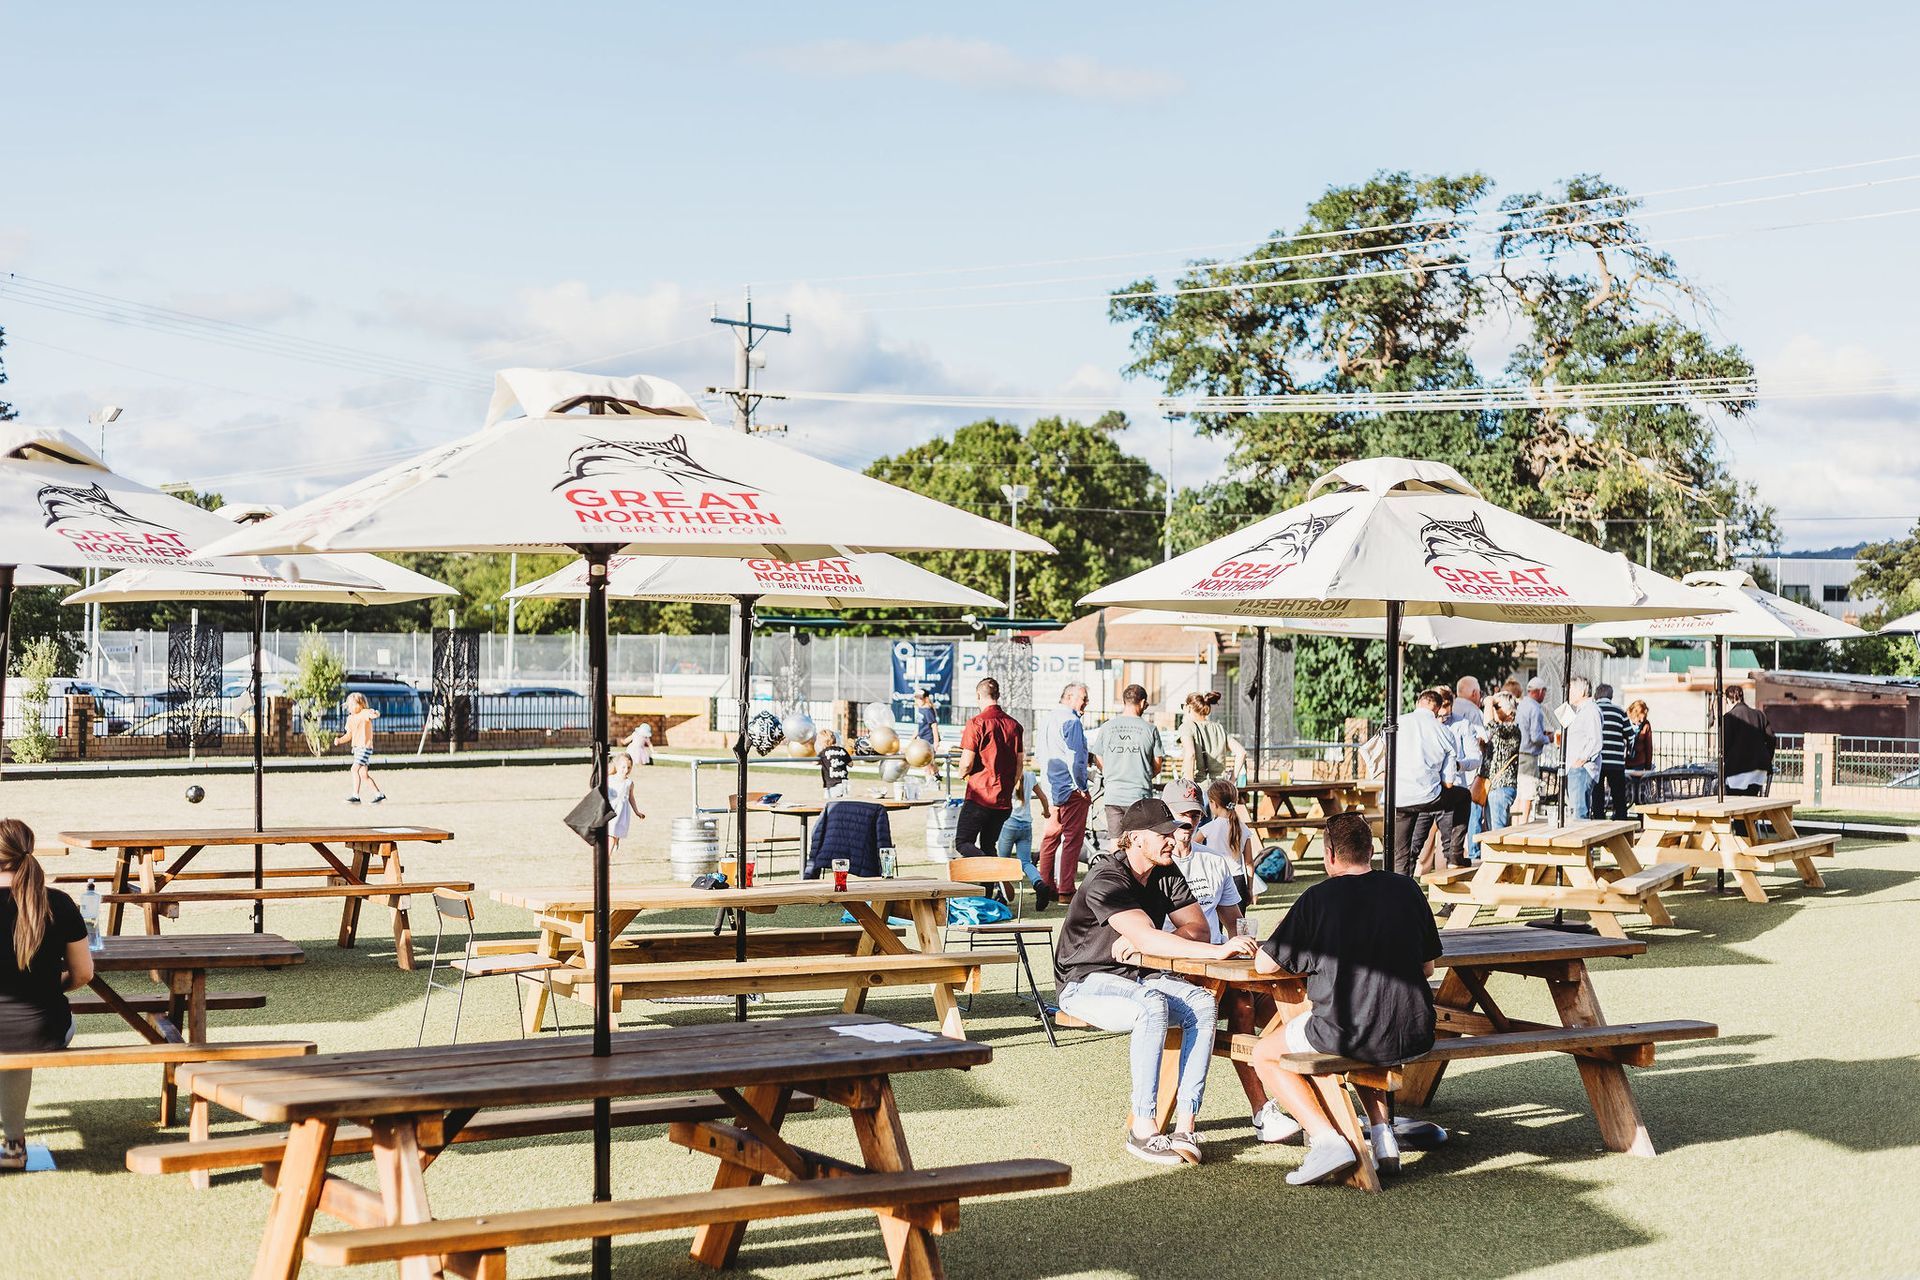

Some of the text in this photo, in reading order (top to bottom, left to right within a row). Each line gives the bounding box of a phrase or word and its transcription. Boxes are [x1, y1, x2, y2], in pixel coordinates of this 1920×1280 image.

[565, 489, 760, 509] GREAT
[575, 510, 782, 525] NORTHERN
[619, 526, 722, 535] BREWING
[56, 528, 187, 548] GREAT
[108, 555, 175, 567] BREWING
[747, 559, 850, 573] GREAT
[1211, 561, 1298, 579] GREAT
[1432, 565, 1551, 585] GREAT
[754, 572, 863, 585] NORTHERN
[1192, 578, 1275, 591] NORTHERN
[778, 582, 832, 592] BREWING
[1445, 582, 1569, 597] NORTHERN
